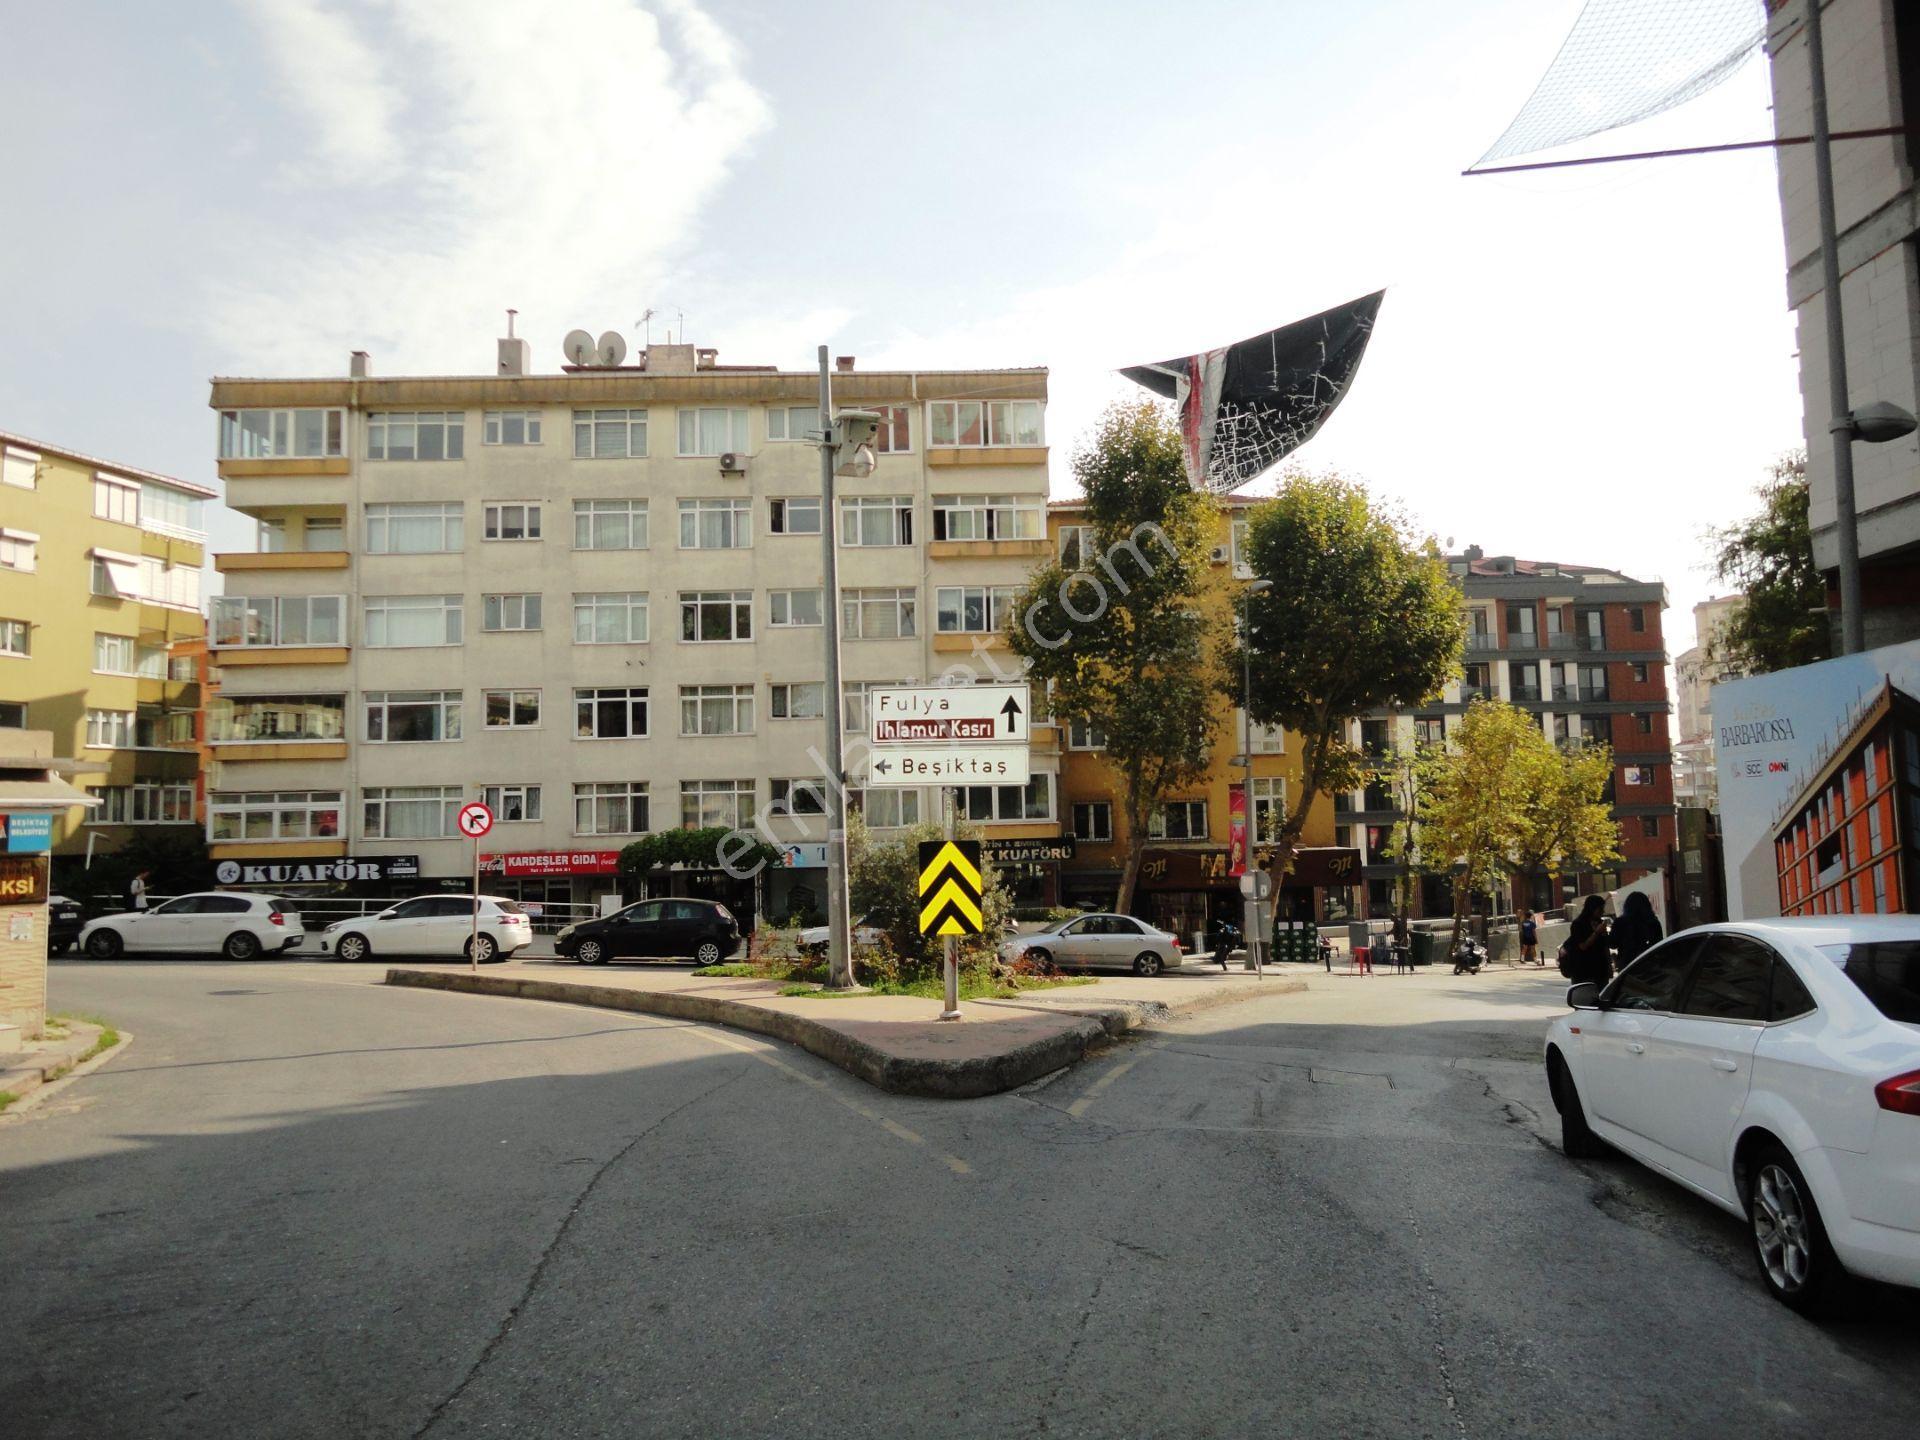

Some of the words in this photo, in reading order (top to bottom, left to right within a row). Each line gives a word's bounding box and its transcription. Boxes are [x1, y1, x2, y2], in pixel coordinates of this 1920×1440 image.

[880, 695, 950, 715] Fulya
[878, 721, 946, 738] Ihlamur
[951, 719, 991, 737] Kasrı
[1720, 718, 1795, 747] BARBAROSSA
[902, 757, 1007, 775] Beşiktaş
[508, 854, 568, 868] KARDEŞLER
[571, 854, 597, 865] GIDA
[998, 846, 1072, 860] KUAFÖRÜ
[243, 858, 382, 883] KUAFÖR
[0, 876, 35, 895] KSİ
